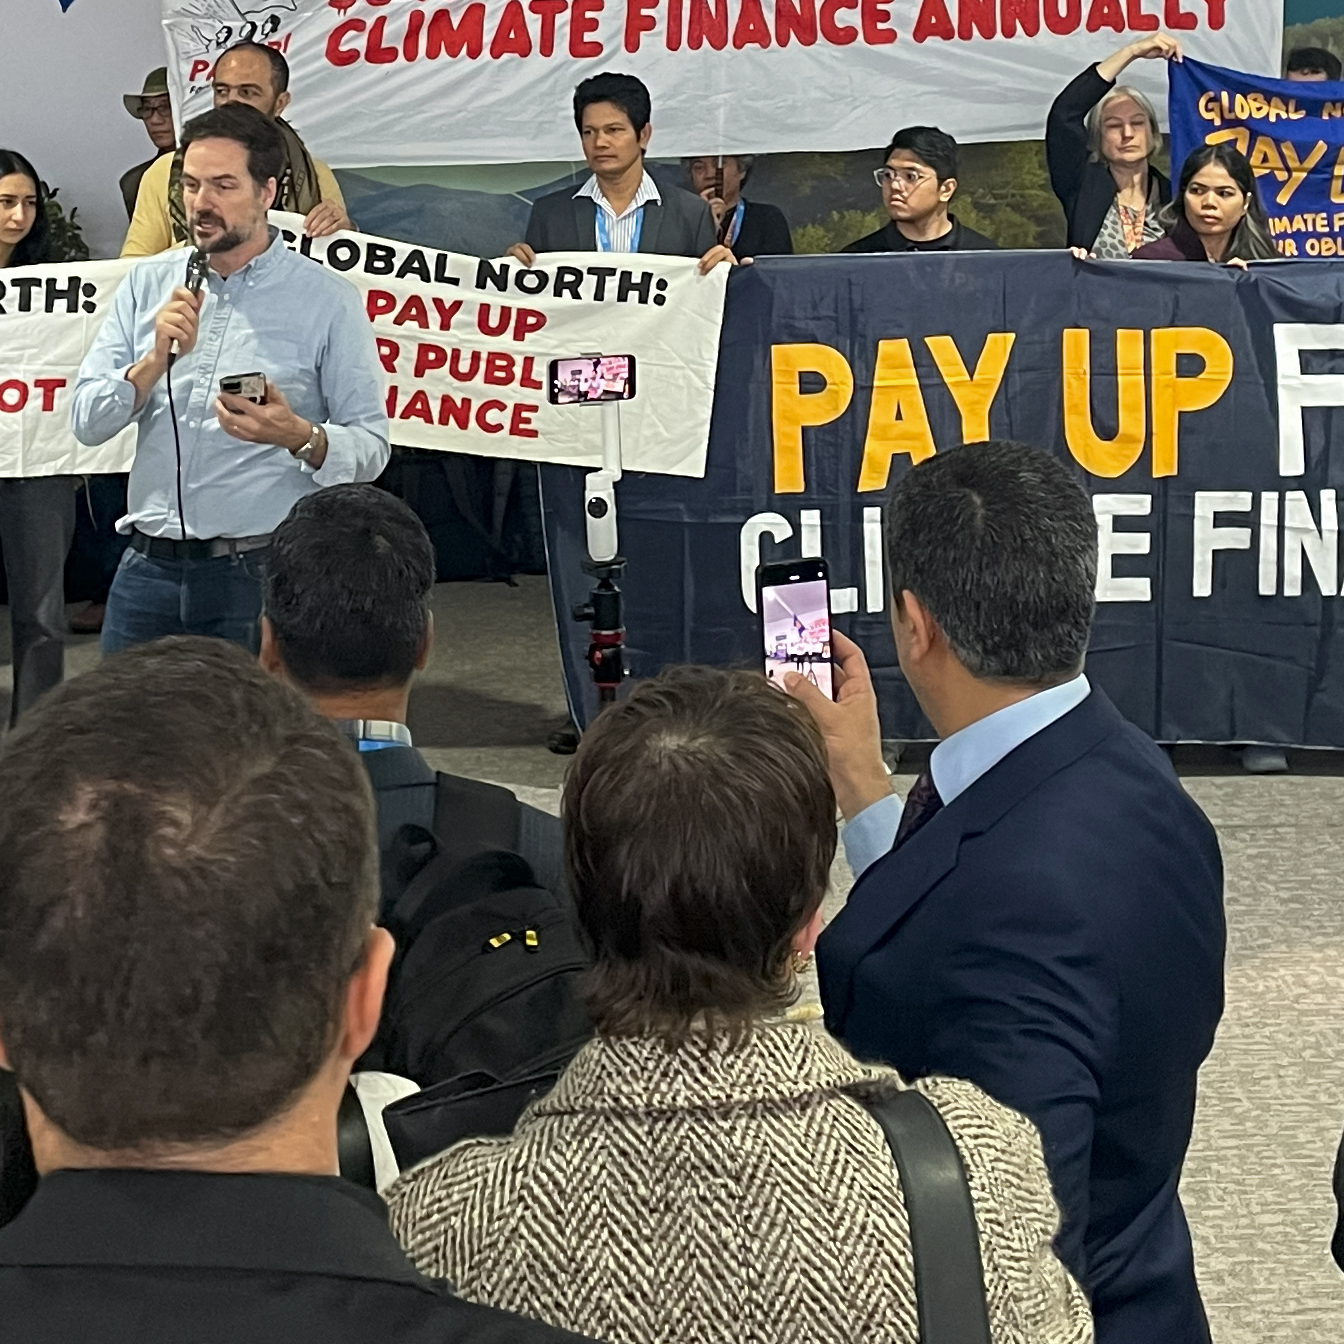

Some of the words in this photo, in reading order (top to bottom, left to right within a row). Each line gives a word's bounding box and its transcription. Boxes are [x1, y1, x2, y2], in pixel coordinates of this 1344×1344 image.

[1198, 91, 1306, 126] GLOBAL
[1268, 210, 1330, 236] IMATE
[475, 258, 668, 307] NORTH:
[366, 289, 463, 331] PAY
[477, 303, 547, 342] UP
[414, 343, 543, 390] PUBL
[770, 332, 1015, 494] PAY
[1063, 326, 1233, 478] UP
